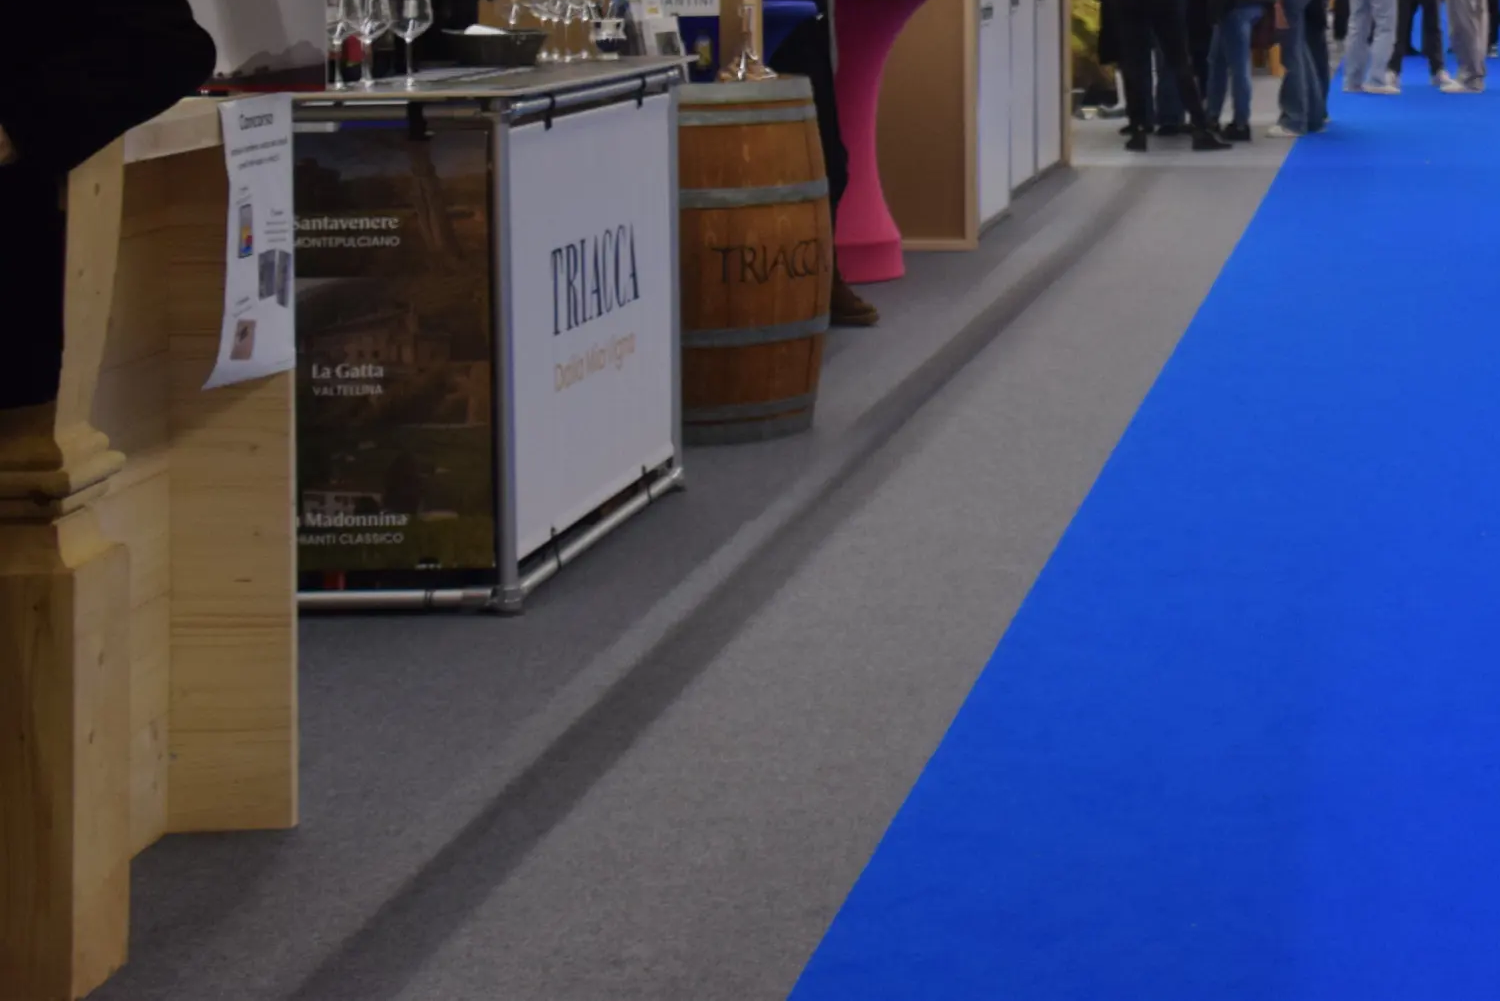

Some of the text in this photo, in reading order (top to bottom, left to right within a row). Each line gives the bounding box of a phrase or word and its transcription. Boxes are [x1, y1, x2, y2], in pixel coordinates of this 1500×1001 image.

[551, 222, 640, 336] TRIACCA
[312, 363, 384, 379] La Gatta
[305, 511, 408, 528] Madonnina
[296, 532, 405, 546] HIANTI CLASSICO
